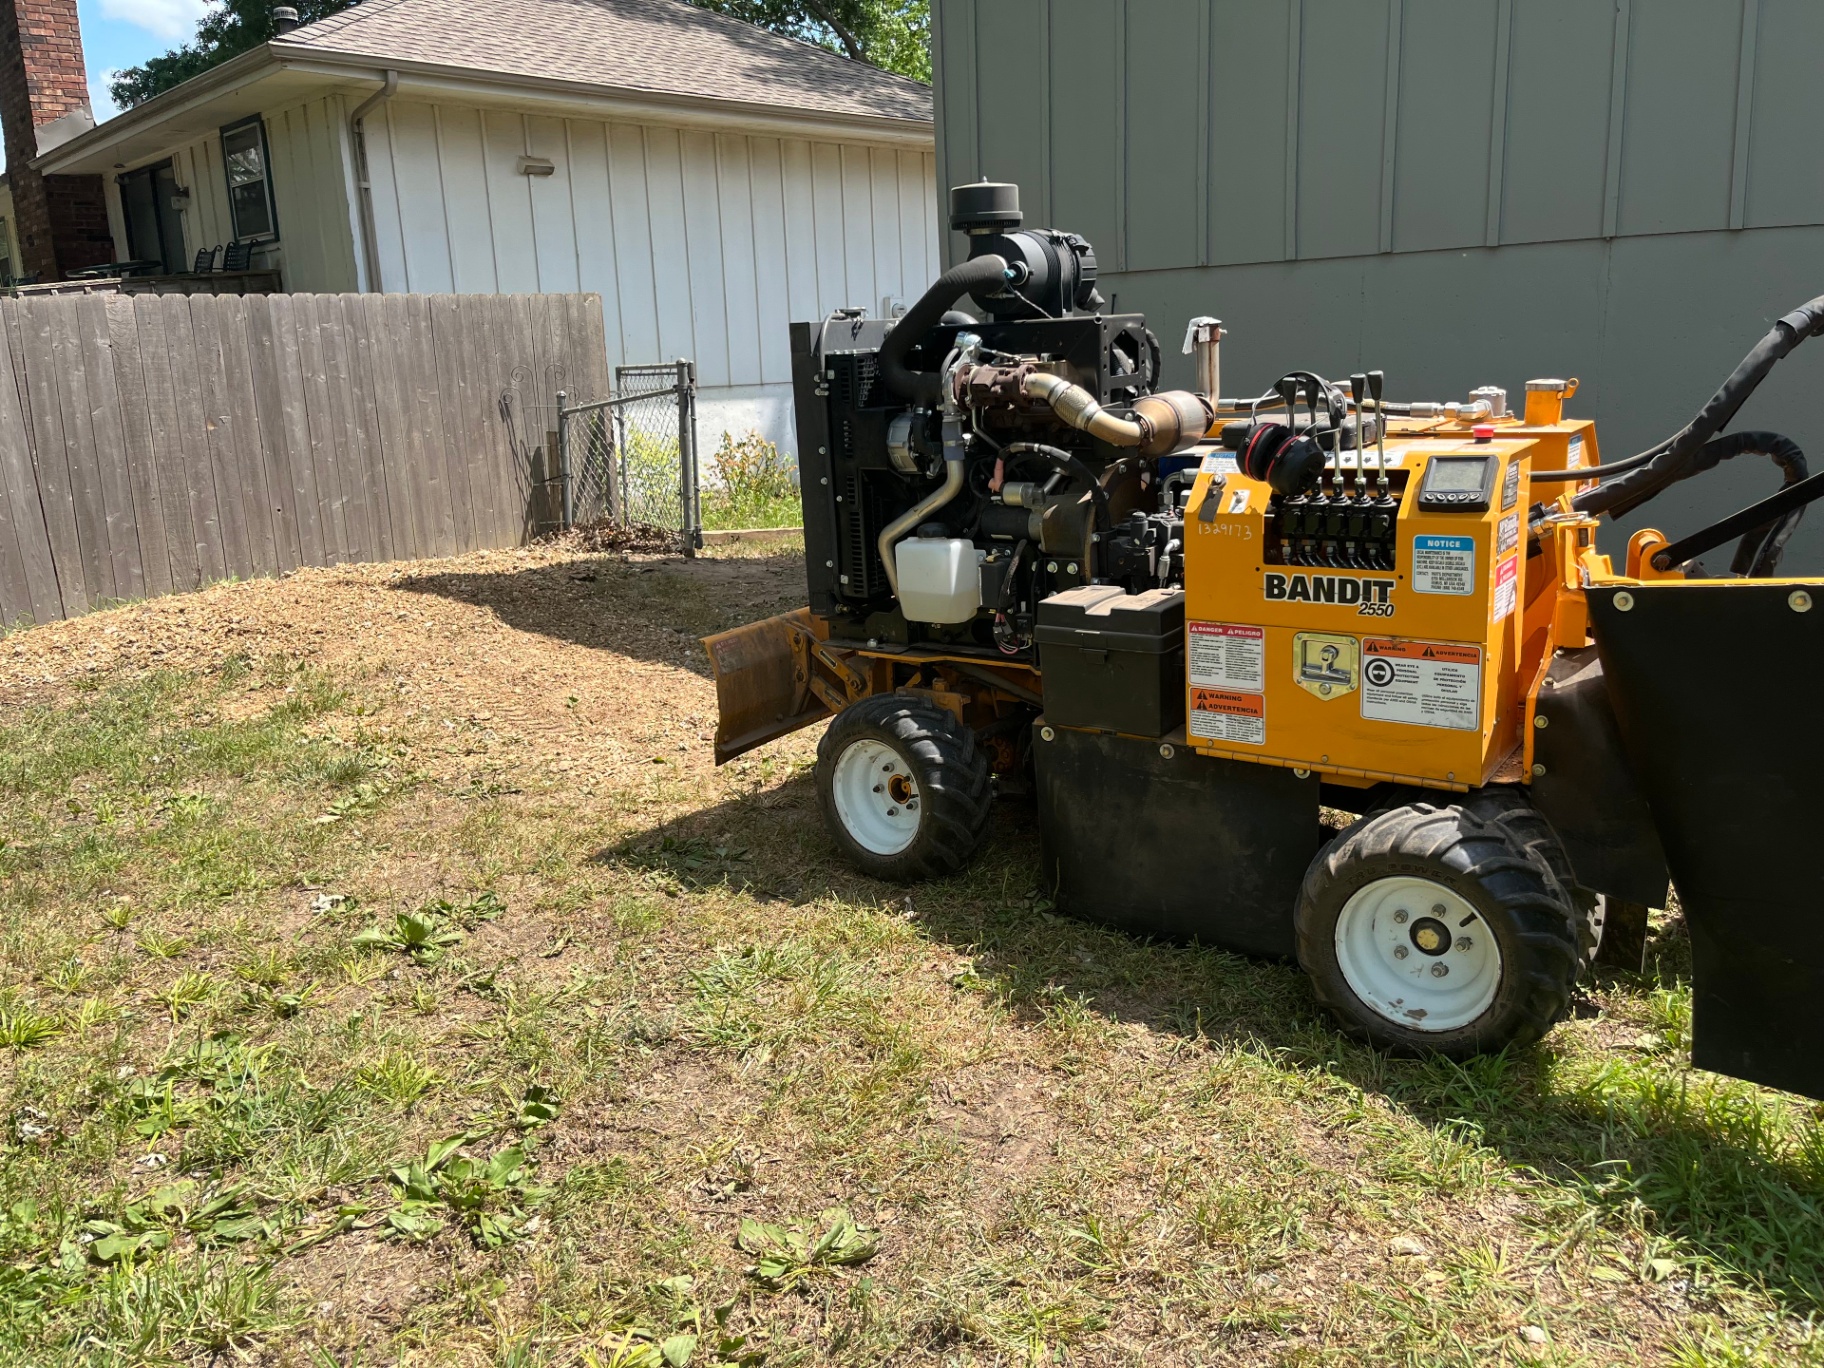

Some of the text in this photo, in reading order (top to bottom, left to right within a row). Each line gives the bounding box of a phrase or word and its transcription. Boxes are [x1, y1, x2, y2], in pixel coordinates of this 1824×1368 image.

[1198, 523, 1252, 540] 1329173
[1427, 539, 1461, 548] NOTICE
[1264, 573, 1395, 604] BANDIT
[1357, 602, 1395, 617] 2550
[1435, 650, 1477, 658] ADVERTENCIA
[1208, 692, 1242, 702] WARNING
[1208, 703, 1258, 714] ADVERTENCIA
